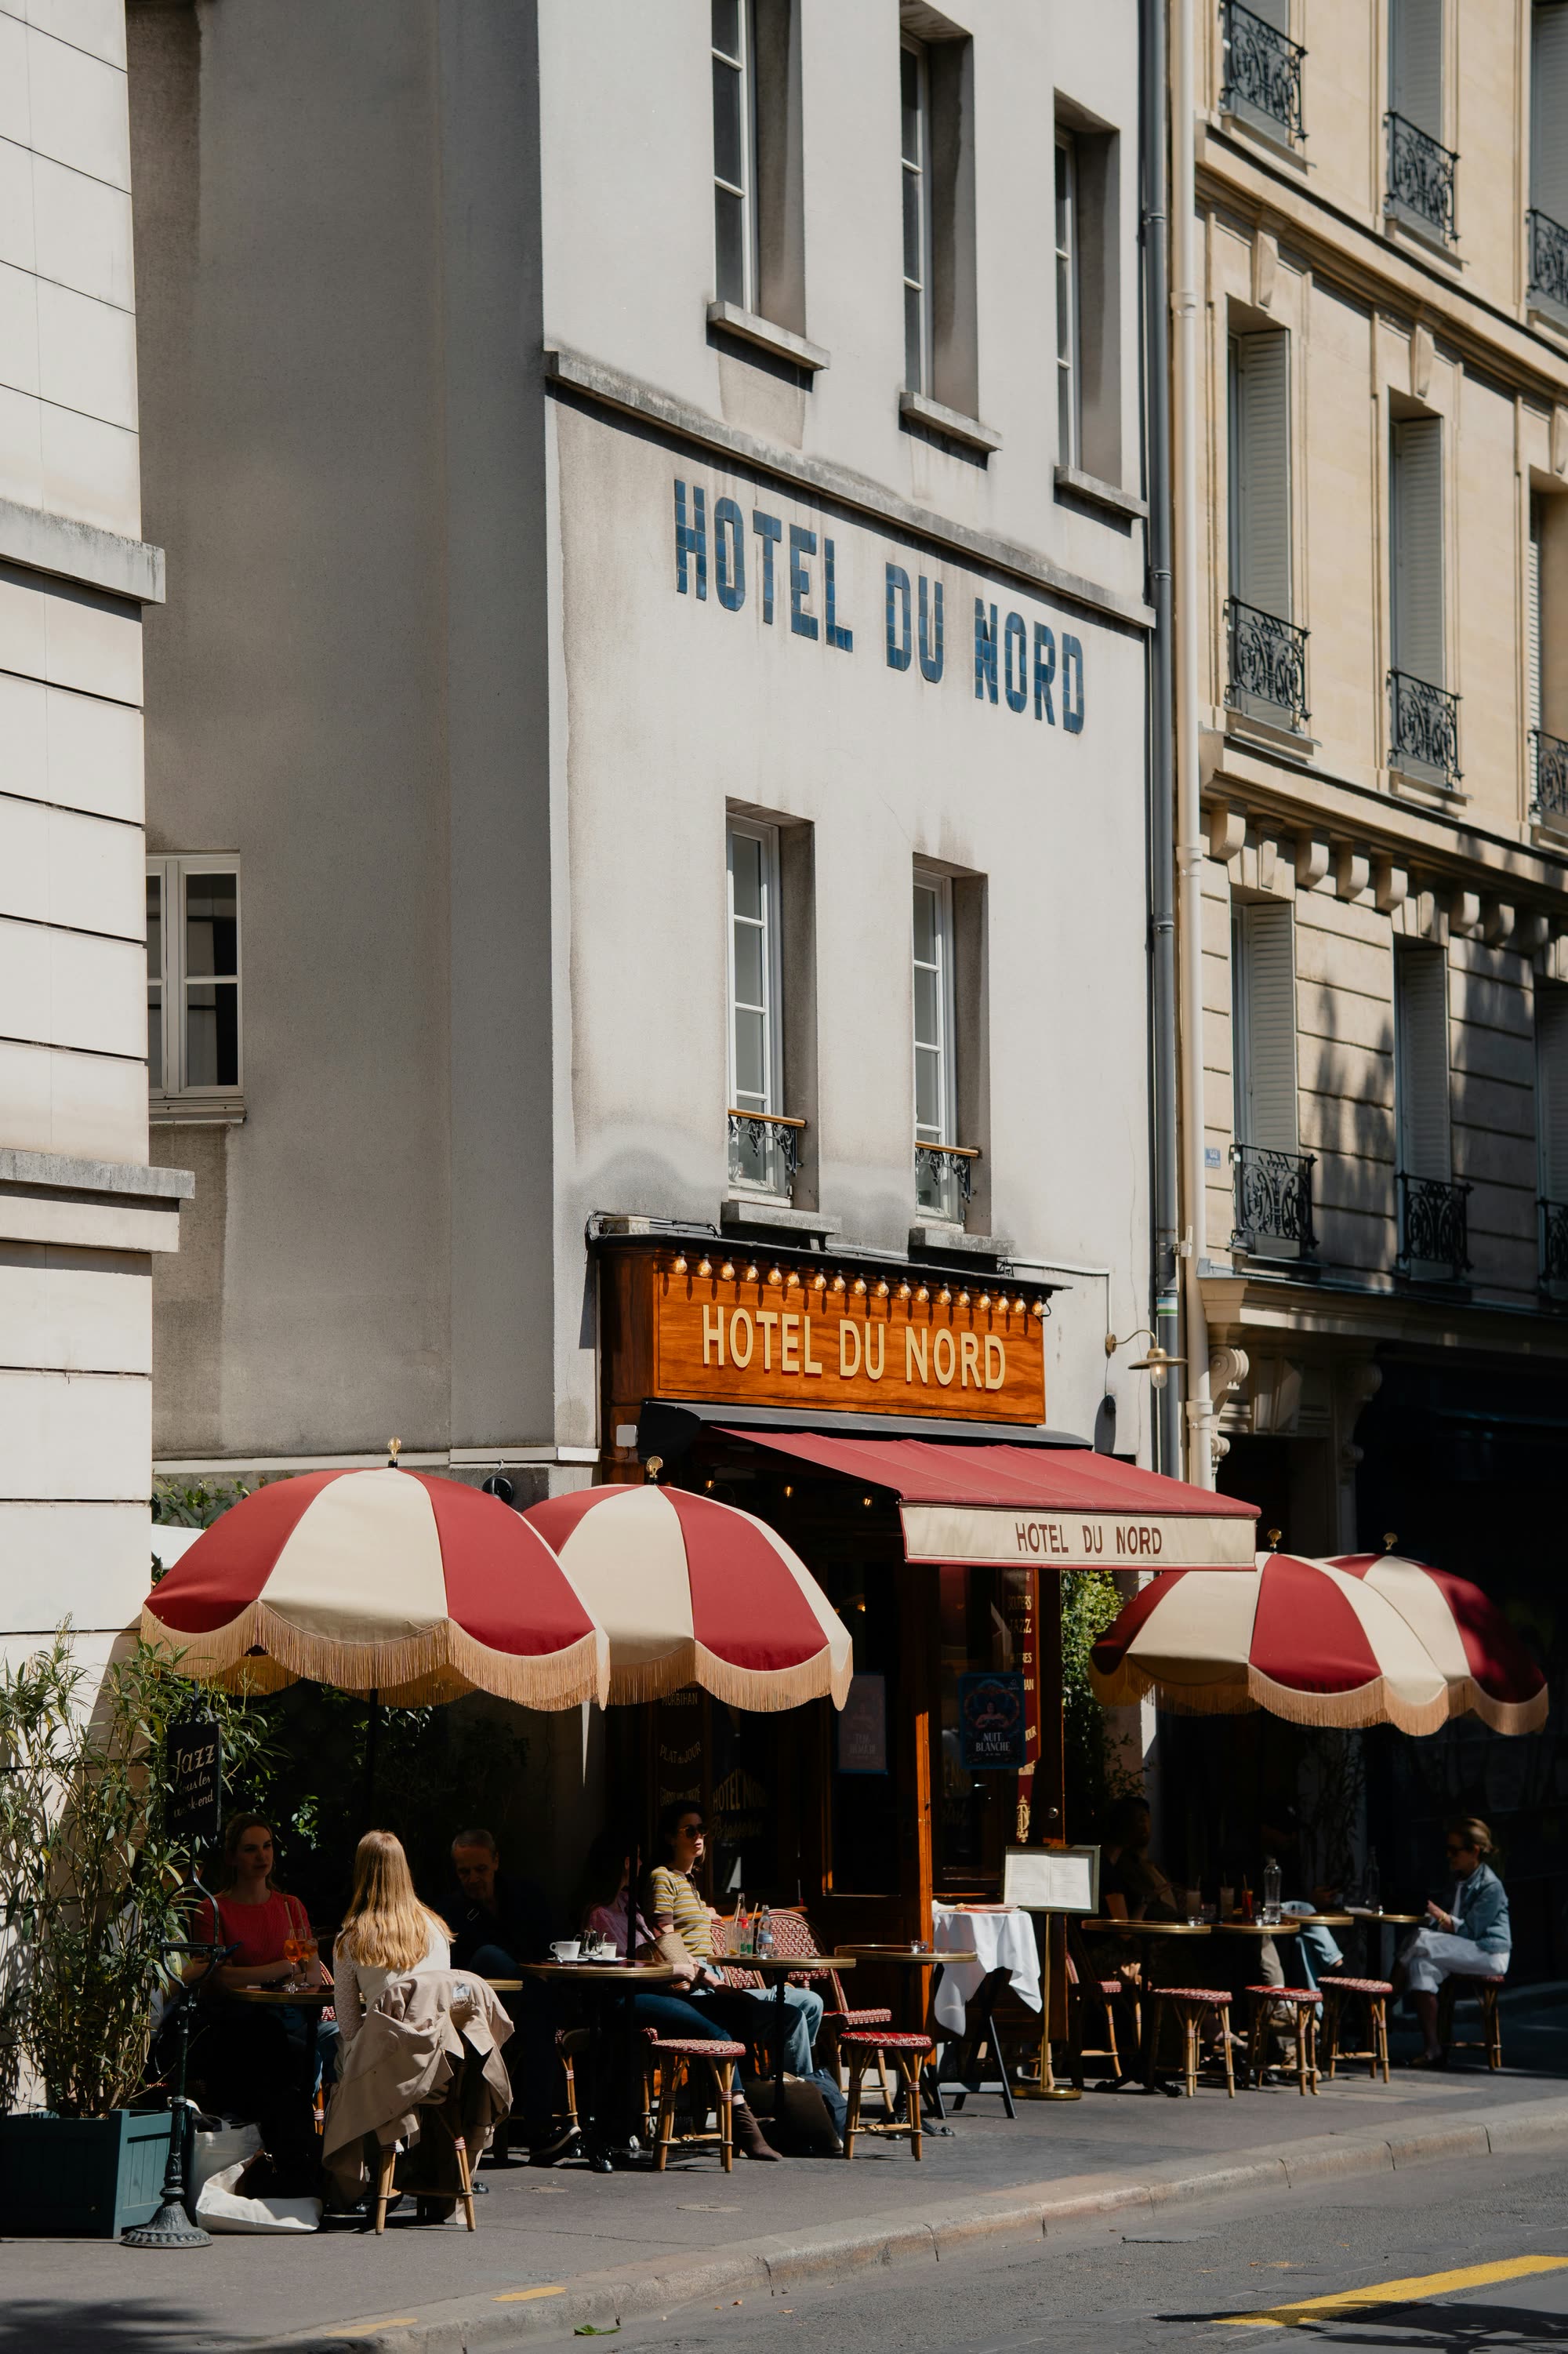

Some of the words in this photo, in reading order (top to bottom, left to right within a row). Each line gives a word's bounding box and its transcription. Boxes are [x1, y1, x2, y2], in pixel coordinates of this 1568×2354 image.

[674, 479, 853, 652] HOTEL
[885, 561, 943, 684] DU
[975, 598, 1084, 735] NORD
[702, 1304, 822, 1375] HOTEL
[839, 1319, 884, 1380] DU
[905, 1326, 1006, 1390] NORD
[1015, 1523, 1069, 1553] HOTEL
[1081, 1525, 1103, 1553] DU
[1116, 1526, 1162, 1554] NORD
[975, 1742, 1011, 1752] BLANCHE
[983, 1732, 1003, 1742] NUIT
[175, 1744, 216, 1784] Jazz
[659, 1744, 677, 1764] PLAT
[684, 1741, 701, 1763] JOUR
[198, 1771, 211, 1788] les
[713, 1769, 740, 1813] HOTEL
[173, 1789, 214, 1818] wk-end
